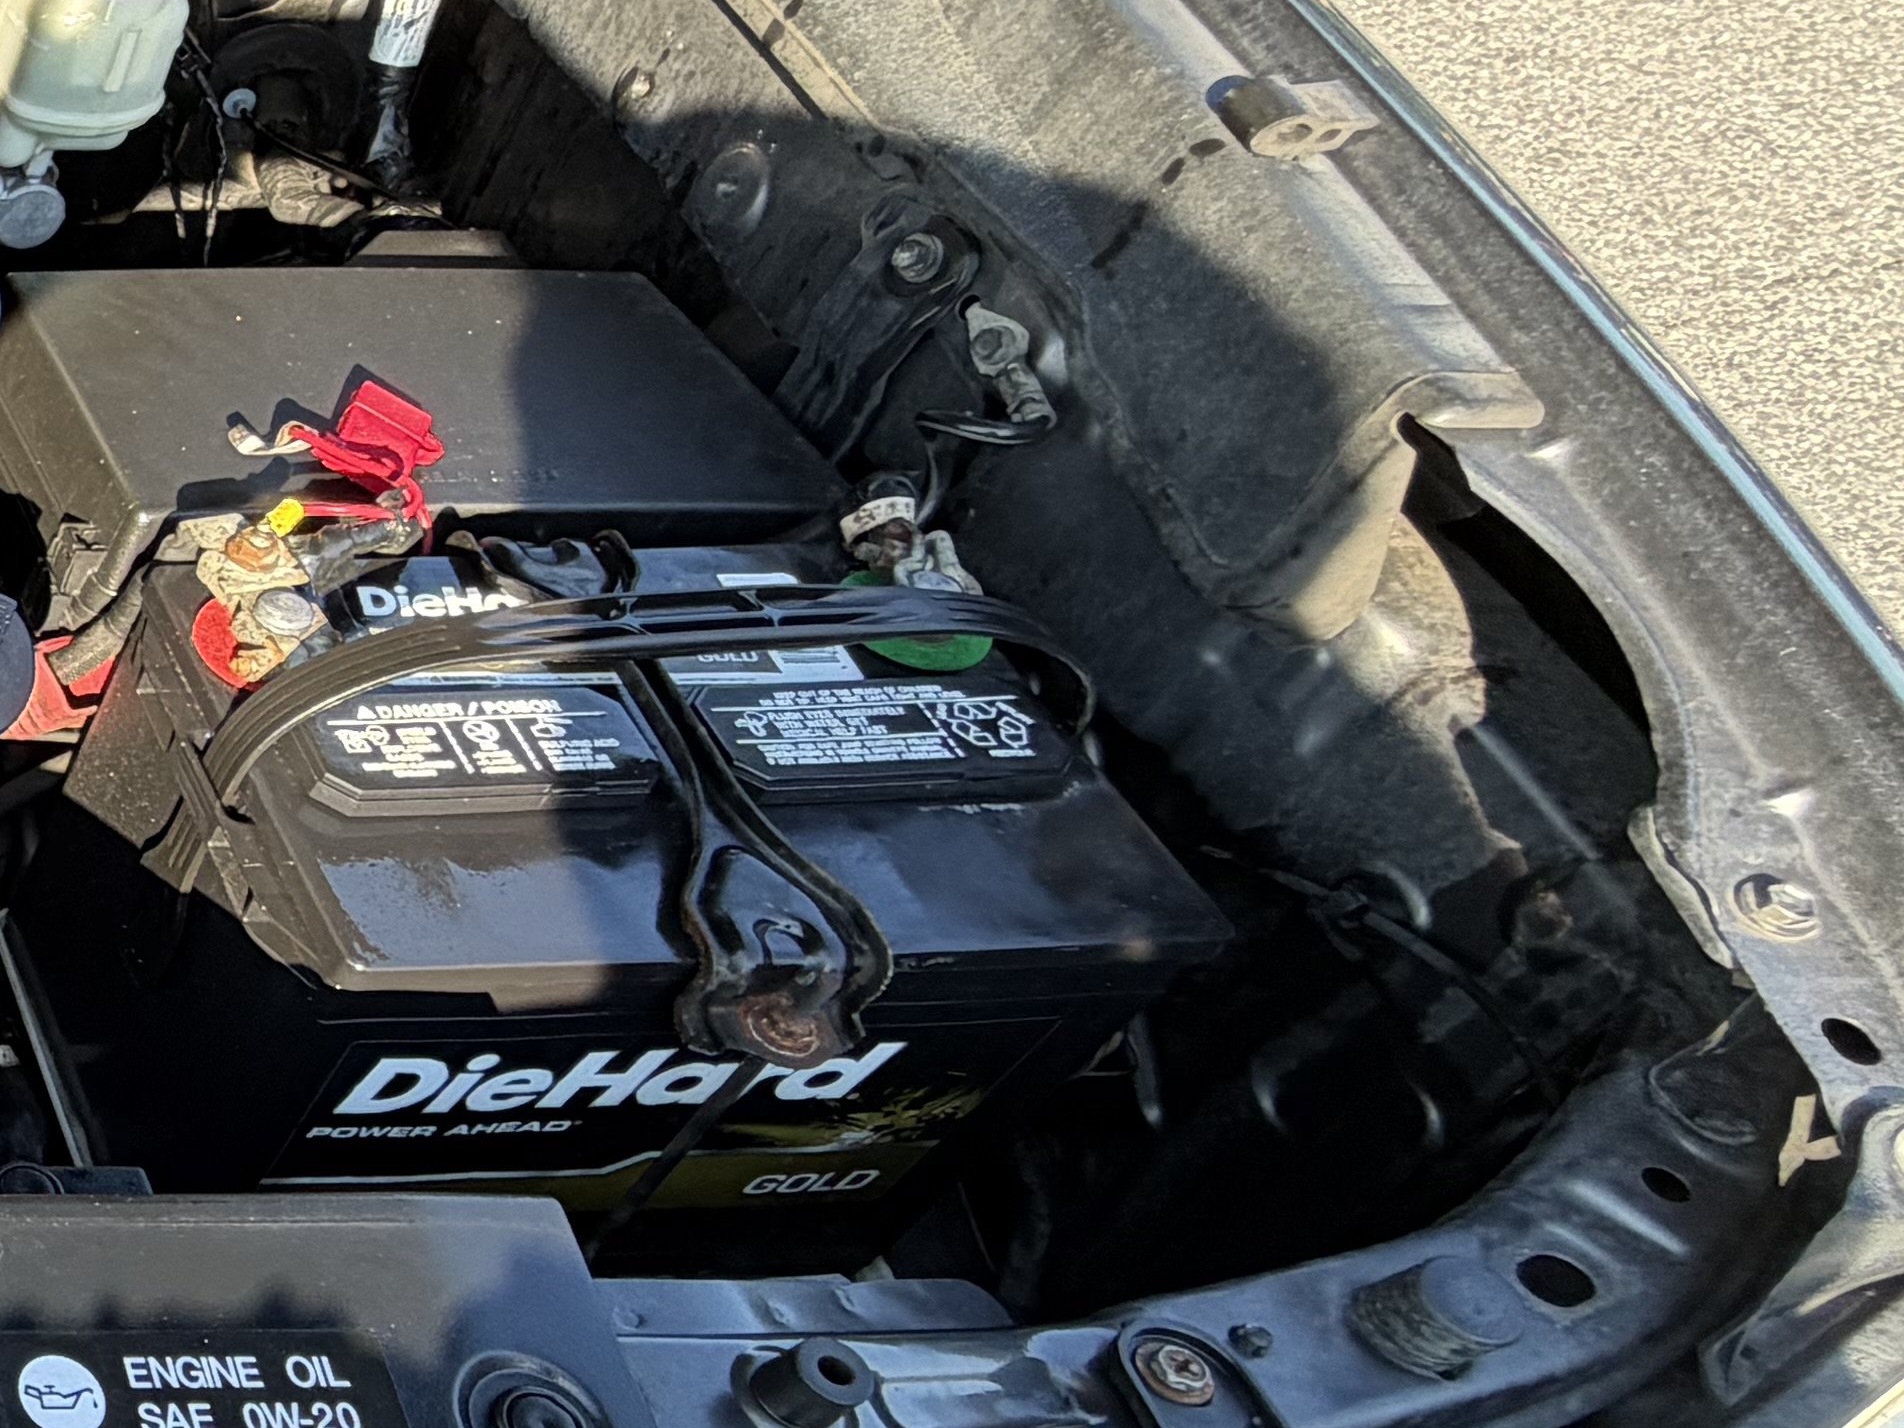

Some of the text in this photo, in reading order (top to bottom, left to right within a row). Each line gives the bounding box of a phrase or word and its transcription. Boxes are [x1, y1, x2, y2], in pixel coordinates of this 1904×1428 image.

[376, 699, 562, 719] DANGER / POISON
[334, 1041, 907, 1113] DieHard
[305, 1120, 572, 1139] POWER AHEAD
[743, 1169, 879, 1195] GOLD
[123, 1355, 352, 1389] ENGINE OIL
